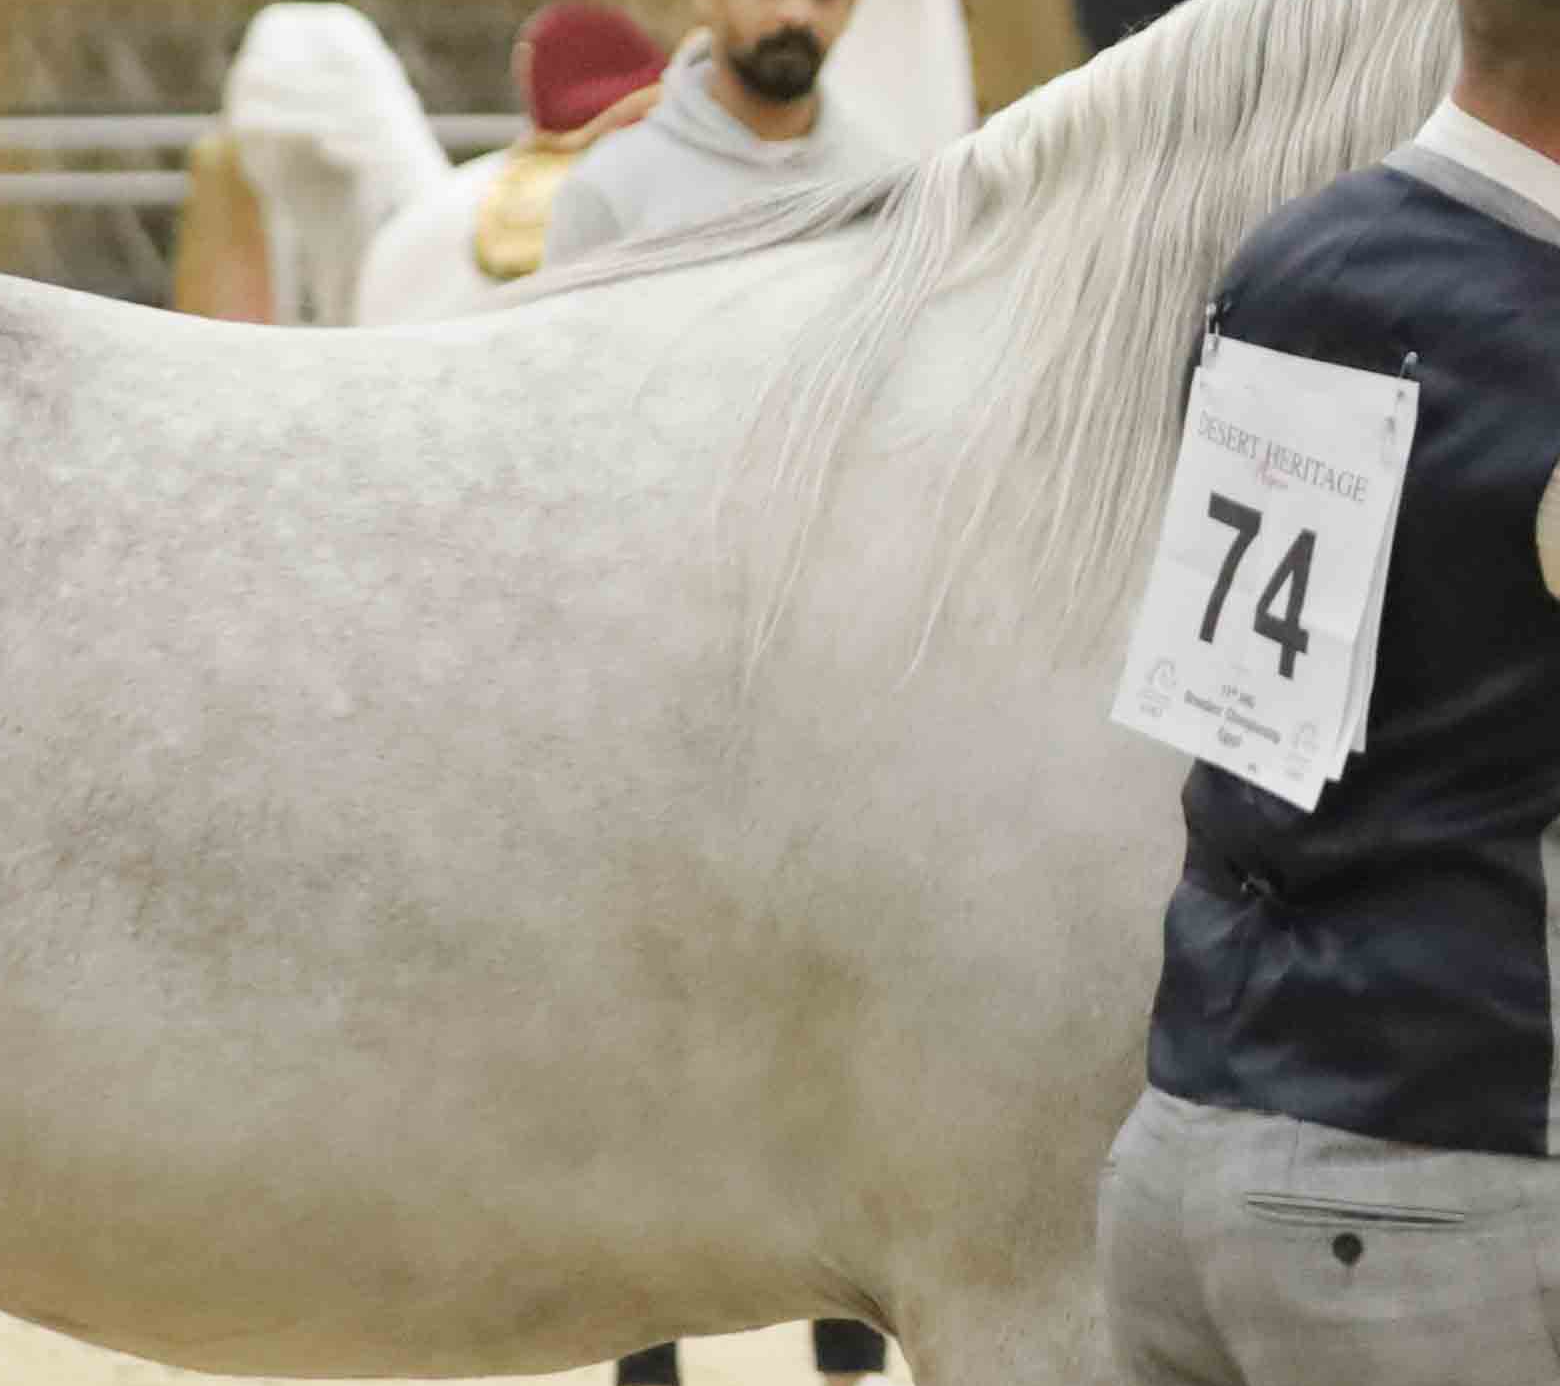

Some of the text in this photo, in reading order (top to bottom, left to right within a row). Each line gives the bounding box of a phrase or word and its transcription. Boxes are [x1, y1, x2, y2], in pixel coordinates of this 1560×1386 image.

[1199, 410, 1261, 460] DESERT
[1261, 440, 1368, 502] HERITAGE
[1200, 489, 1316, 680] 74
